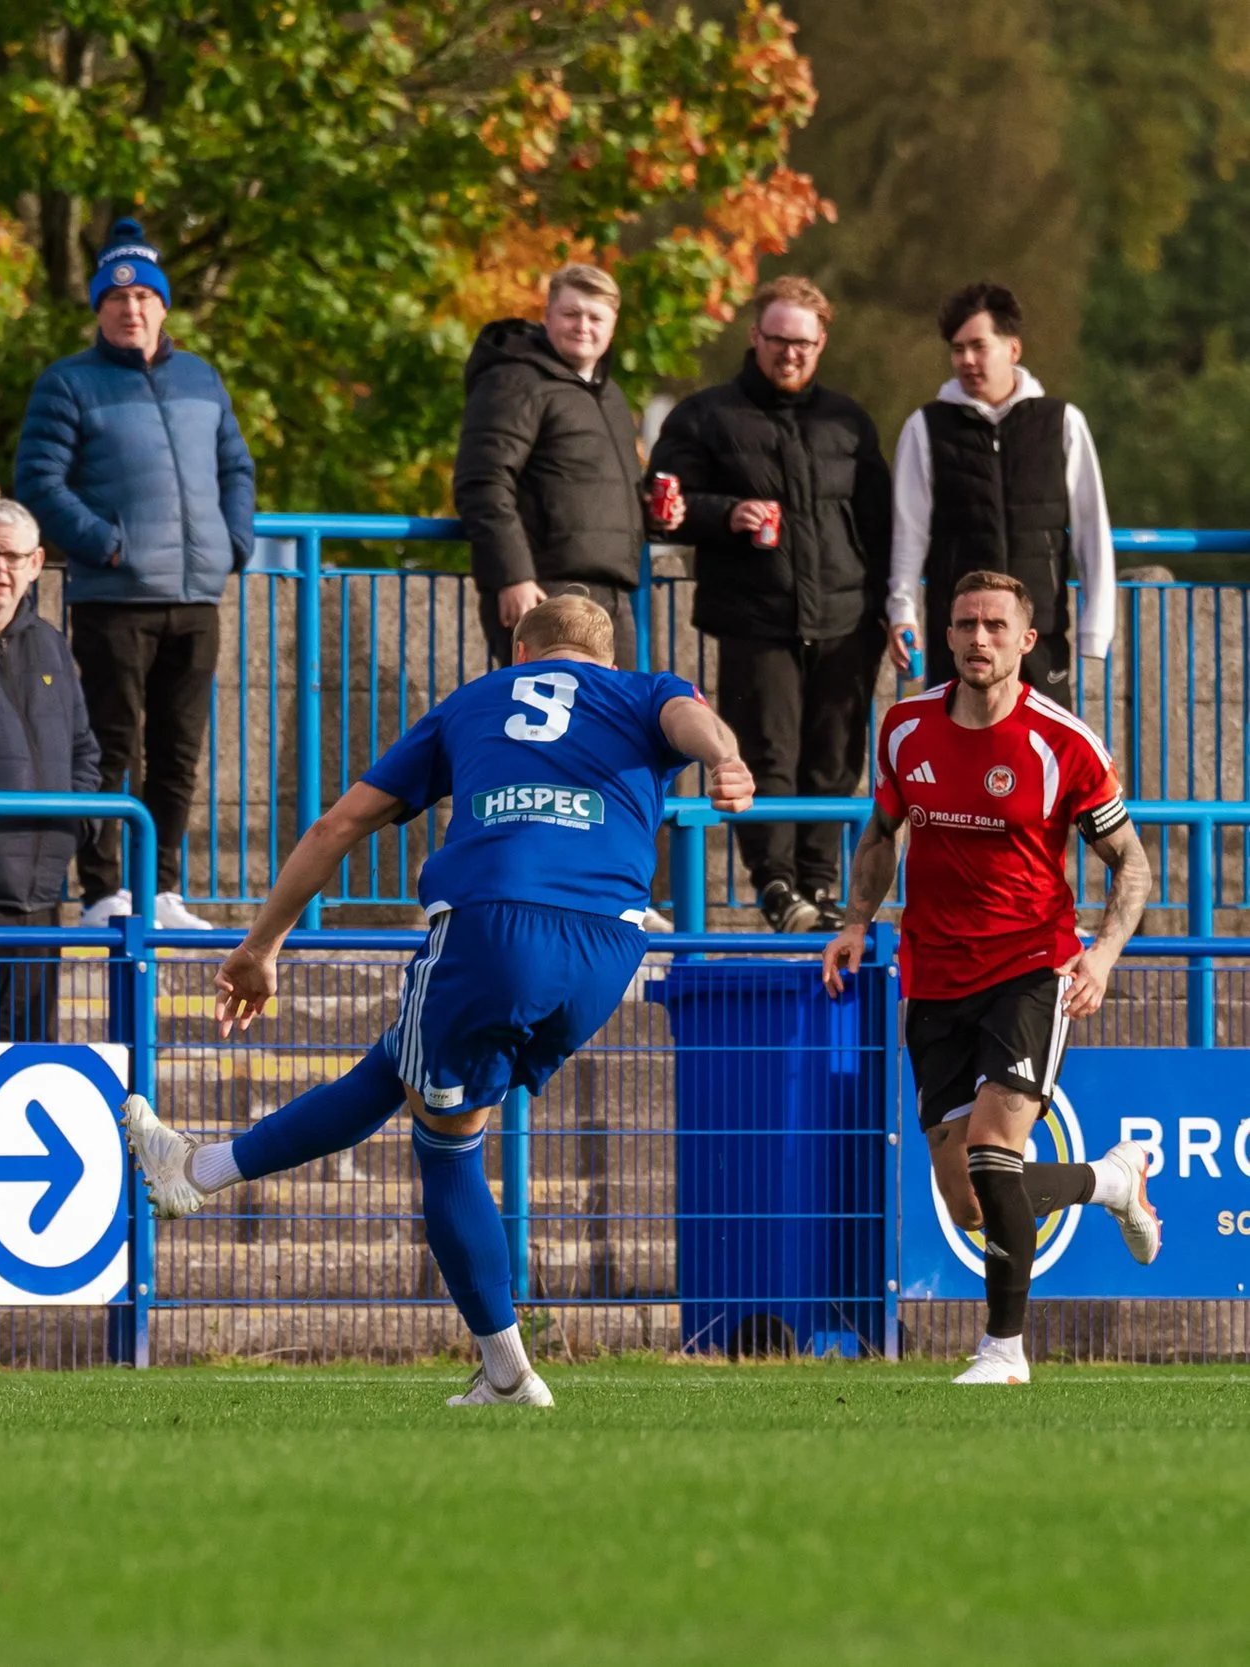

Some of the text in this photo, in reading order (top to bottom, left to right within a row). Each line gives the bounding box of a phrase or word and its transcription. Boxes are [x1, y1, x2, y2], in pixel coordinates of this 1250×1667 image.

[504, 672, 579, 742] 9
[485, 786, 590, 817] HiSPEC
[929, 811, 973, 824] PROJECT
[974, 815, 1006, 828] SOLAR
